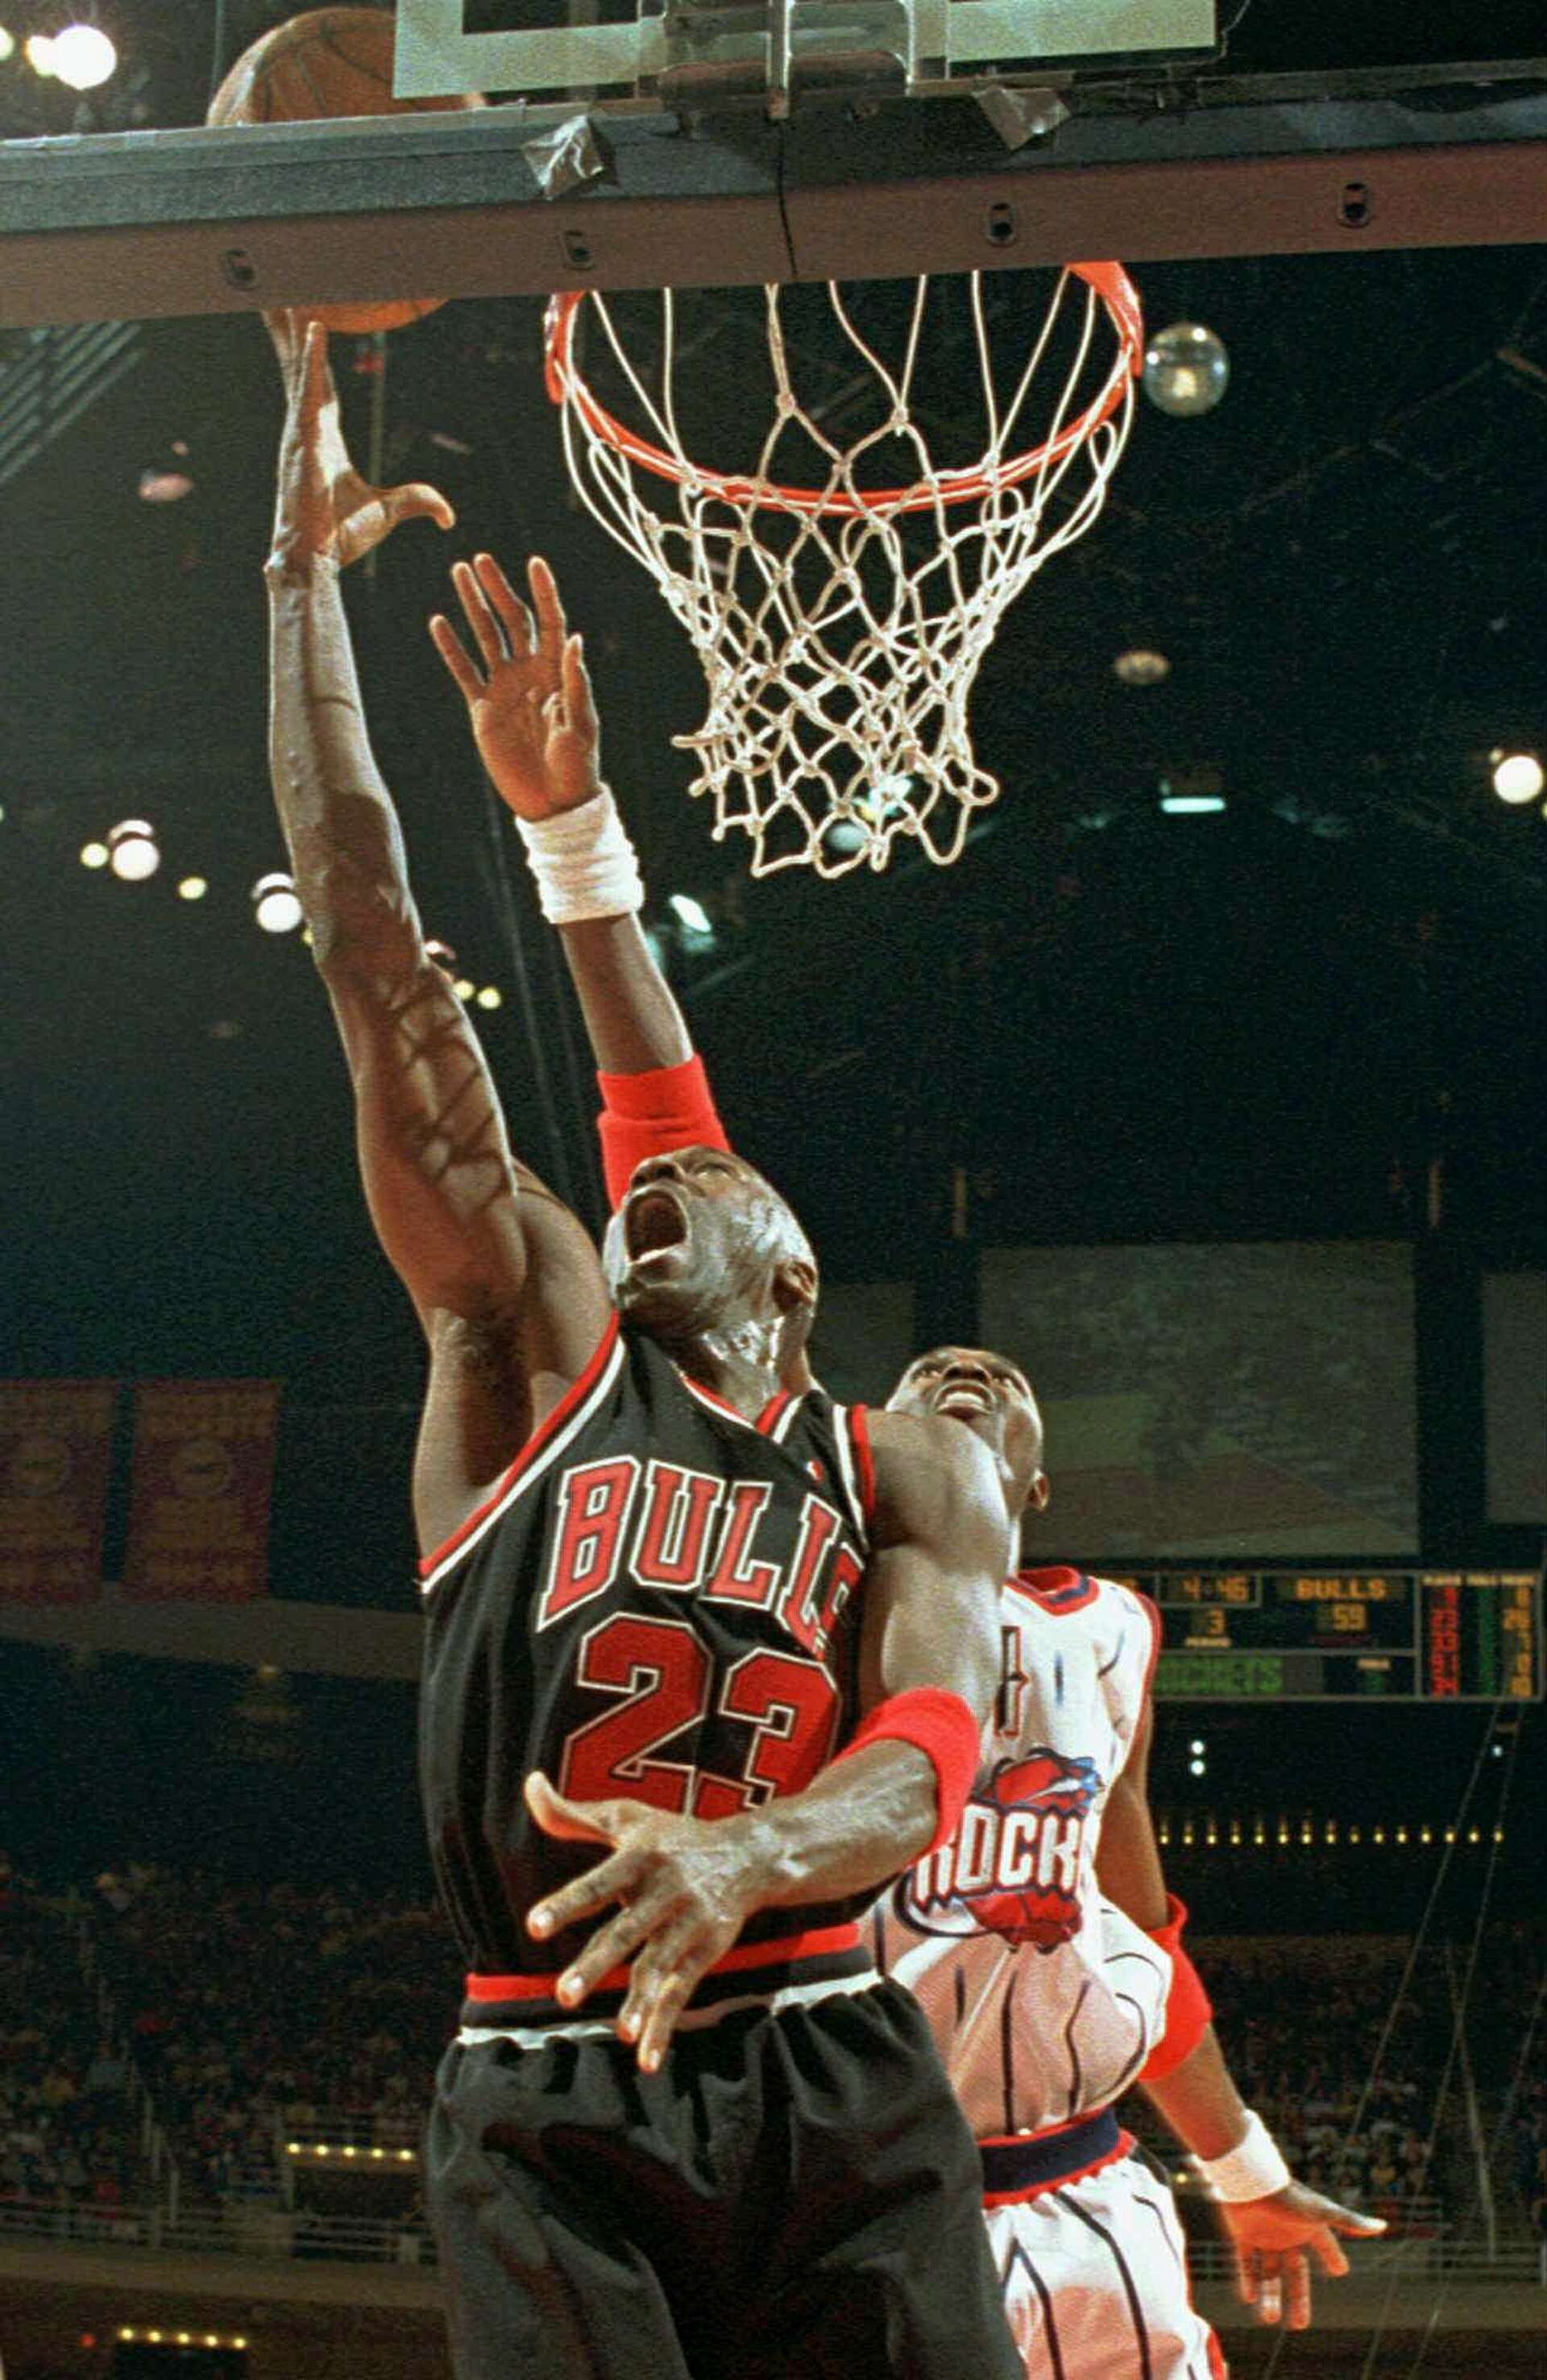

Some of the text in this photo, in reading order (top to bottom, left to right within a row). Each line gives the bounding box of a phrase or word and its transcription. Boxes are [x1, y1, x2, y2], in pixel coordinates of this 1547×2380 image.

[1296, 1577, 1386, 1600] BULLS
[1206, 1609, 1225, 1634] 3
[1333, 1604, 1367, 1631] 59
[559, 1612, 843, 1822] 23
